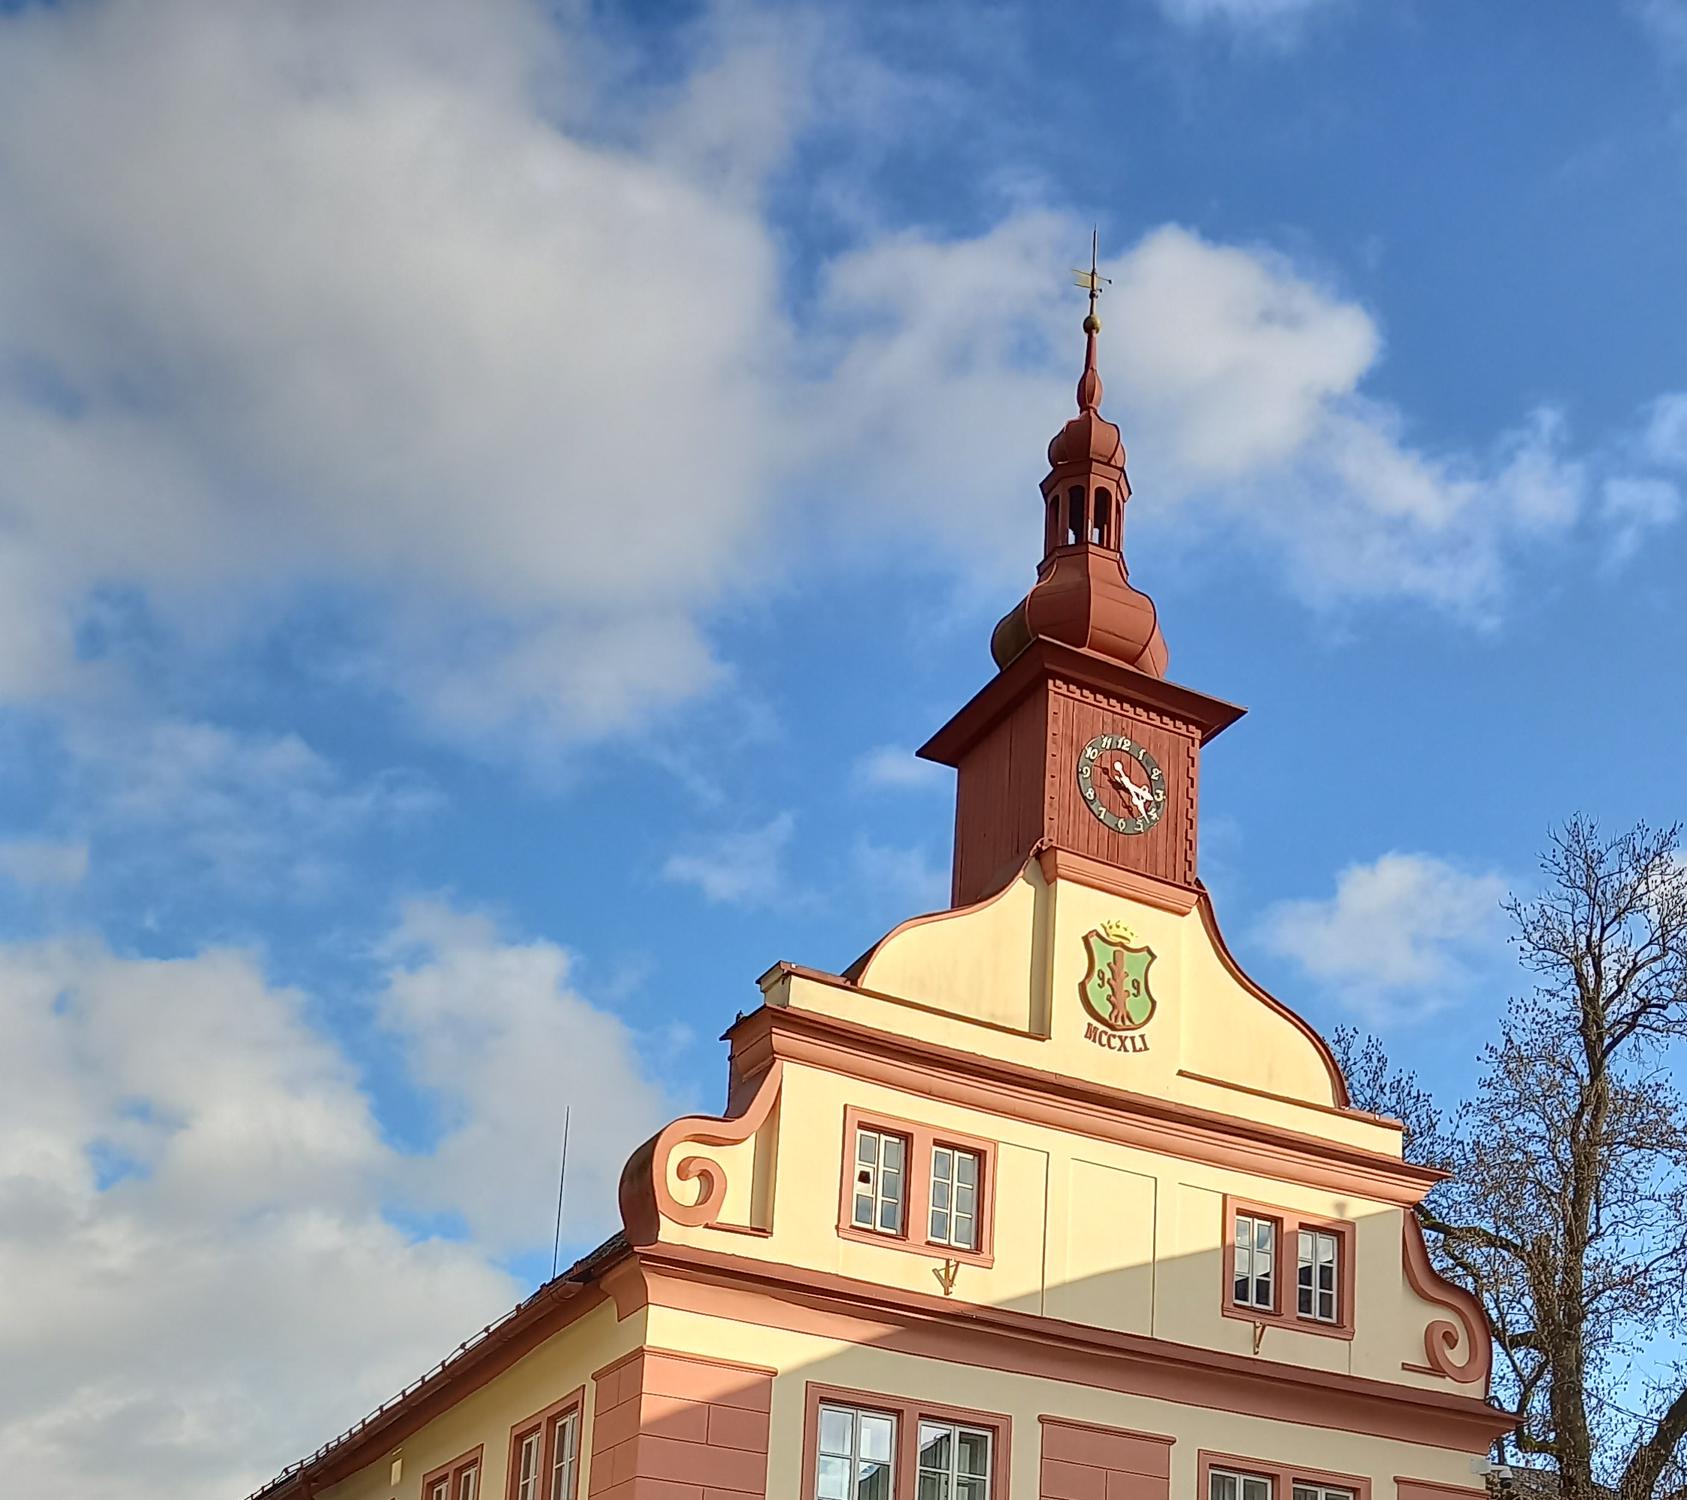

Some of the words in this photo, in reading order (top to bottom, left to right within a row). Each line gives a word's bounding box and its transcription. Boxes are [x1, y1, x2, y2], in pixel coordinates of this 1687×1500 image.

[1101, 734, 1113, 749] 11
[1117, 736, 1131, 751] 12
[1085, 746, 1099, 760] 10
[1137, 748, 1147, 761] 1
[1082, 767, 1091, 779] 9
[1150, 768, 1162, 781] 2
[1085, 788, 1096, 800] 8
[1154, 790, 1165, 802] 3
[1098, 807, 1107, 820] 7
[1147, 807, 1159, 821] 4
[1117, 818, 1126, 831] 6
[1134, 816, 1145, 832] 5
[1083, 1022, 1150, 1053] MCCXLI
